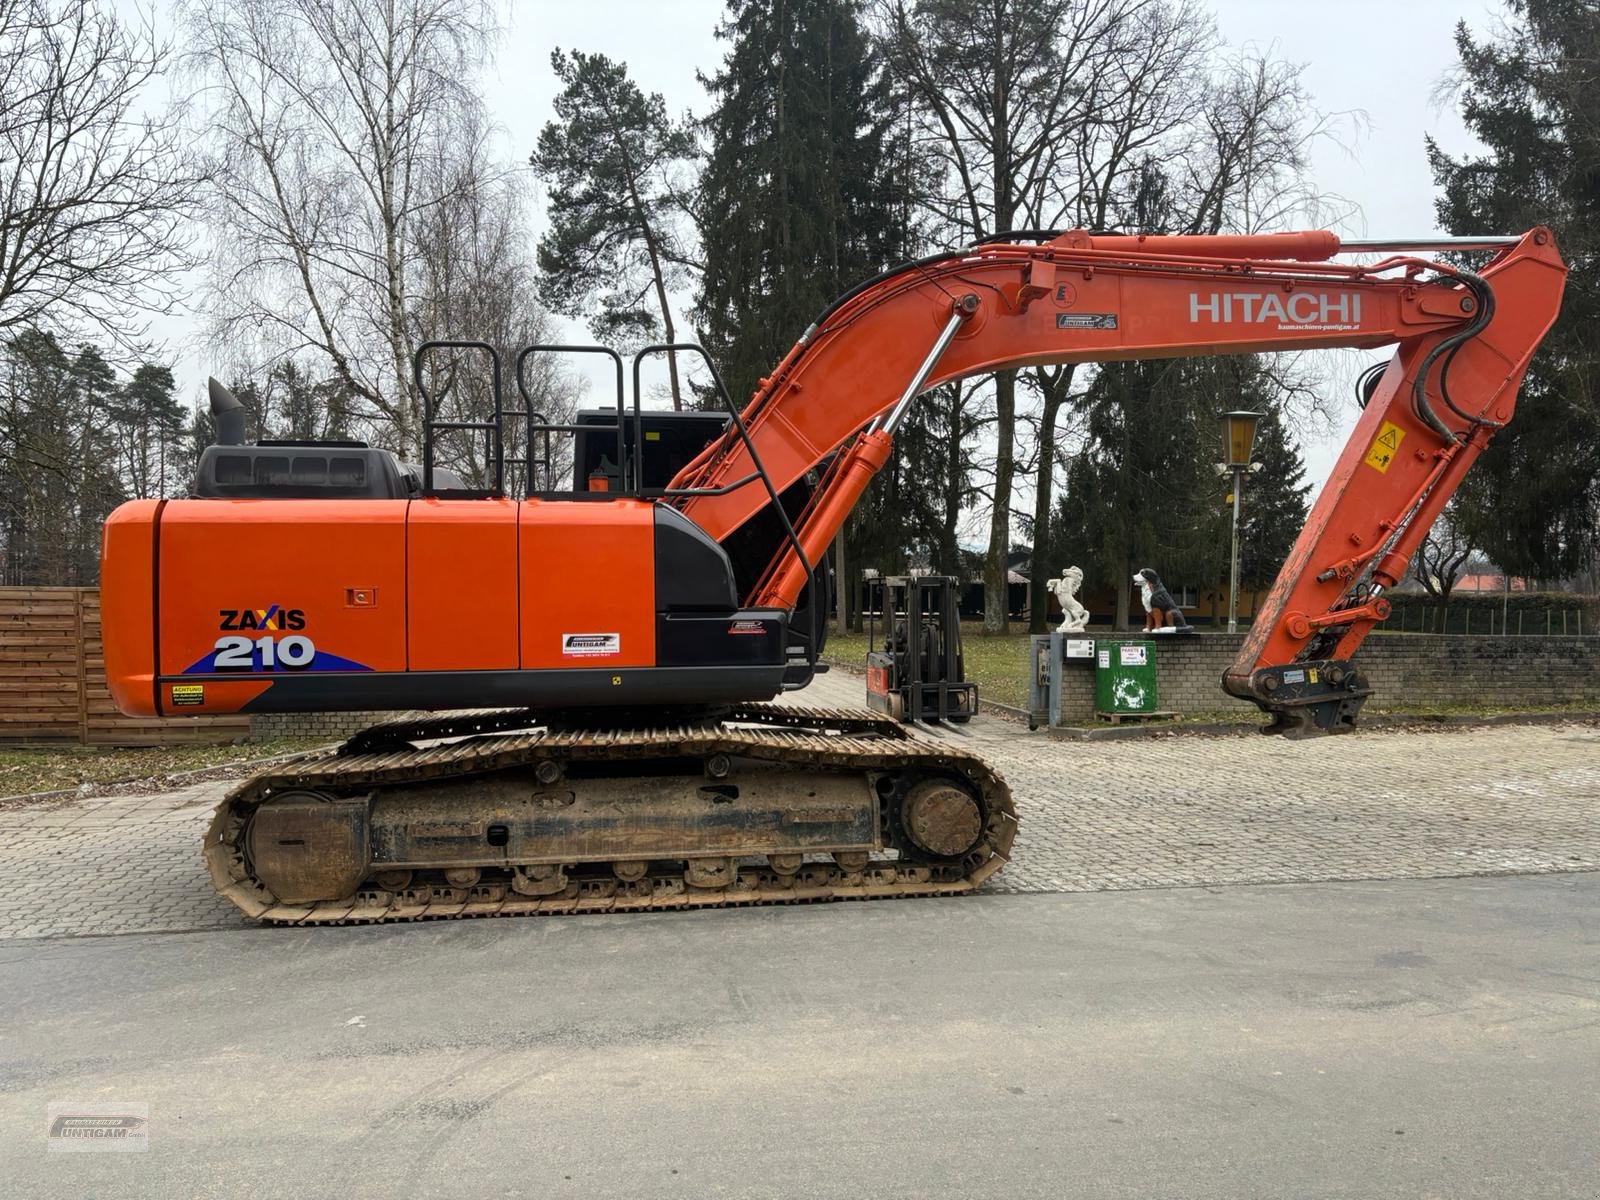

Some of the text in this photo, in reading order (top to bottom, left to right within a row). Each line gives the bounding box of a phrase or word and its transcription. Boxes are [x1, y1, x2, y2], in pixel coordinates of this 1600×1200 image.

[1189, 293, 1361, 323] HITACHI
[219, 604, 306, 631] ZAXIS
[214, 635, 315, 667] 210
